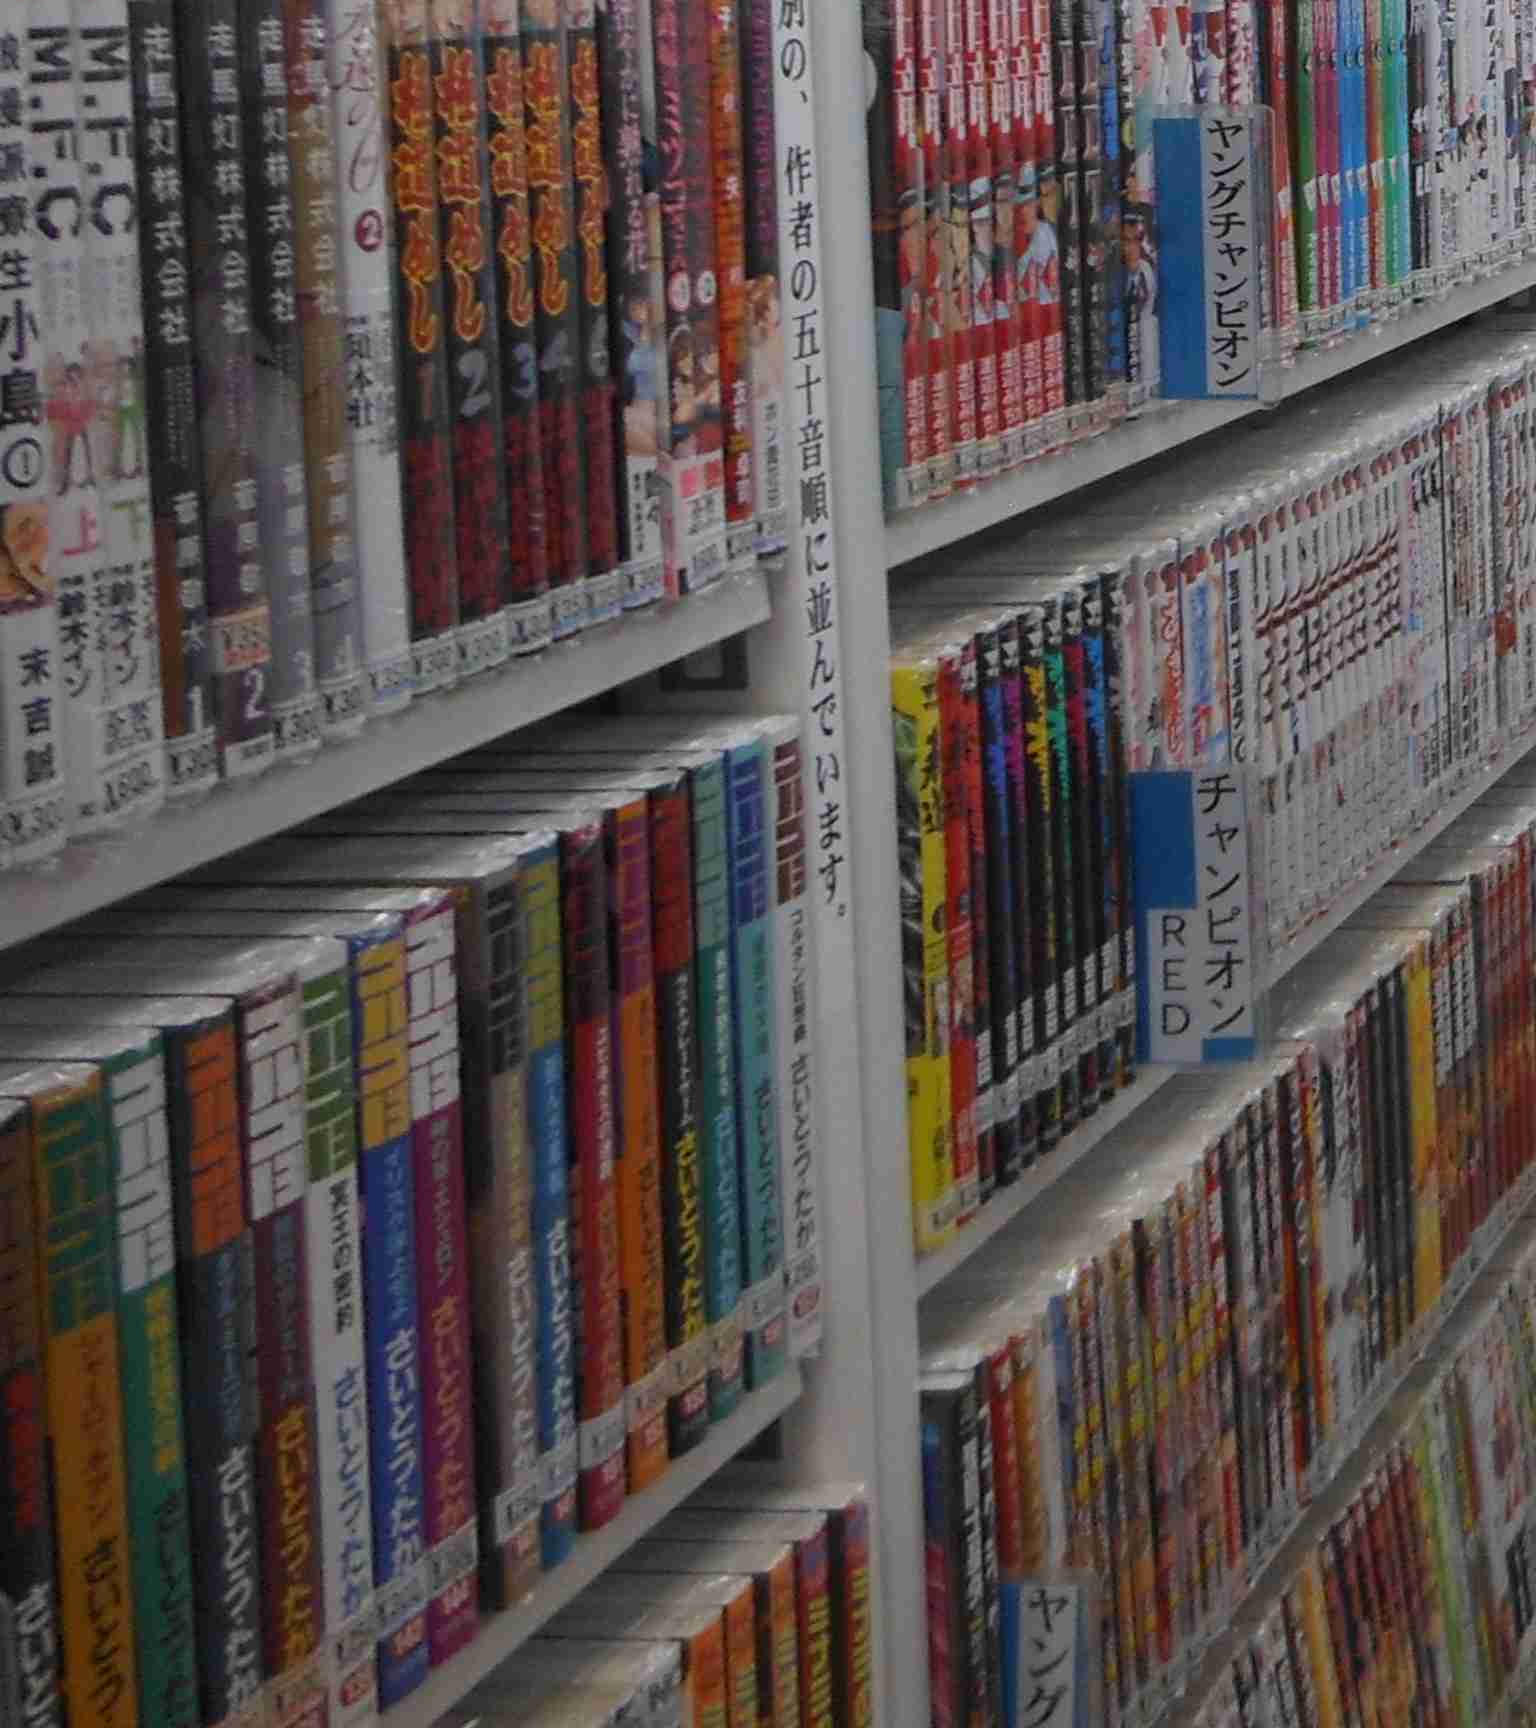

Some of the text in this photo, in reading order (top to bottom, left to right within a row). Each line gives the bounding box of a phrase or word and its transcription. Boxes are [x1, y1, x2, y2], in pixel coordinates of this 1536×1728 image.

[1207, 118, 1251, 389] ヤングチャンピオン
[456, 348, 494, 417] 2
[1160, 913, 1191, 1039] RED
[1197, 772, 1252, 1032] チャンピオン
